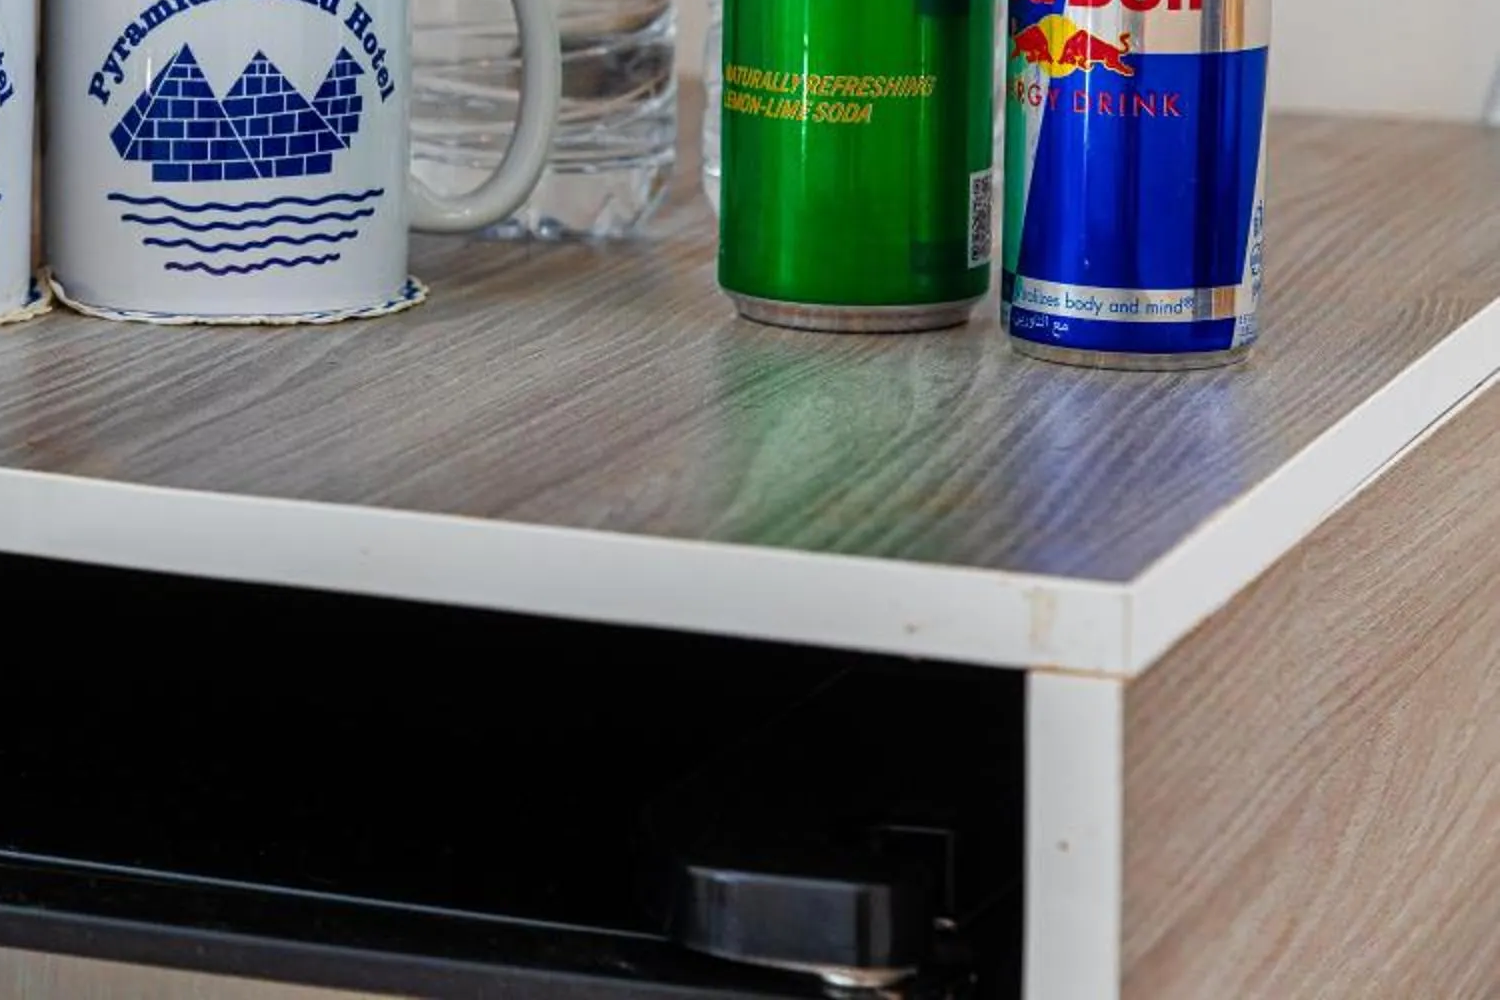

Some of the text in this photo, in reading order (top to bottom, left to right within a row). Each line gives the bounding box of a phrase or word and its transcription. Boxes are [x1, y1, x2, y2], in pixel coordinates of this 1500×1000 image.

[345, 3, 396, 104] Hotel
[805, 73, 937, 98] REFRESHING
[812, 101, 873, 124] SODA
[1073, 88, 1182, 118] DRINK
[1065, 291, 1102, 316] body
[1109, 297, 1139, 314] and
